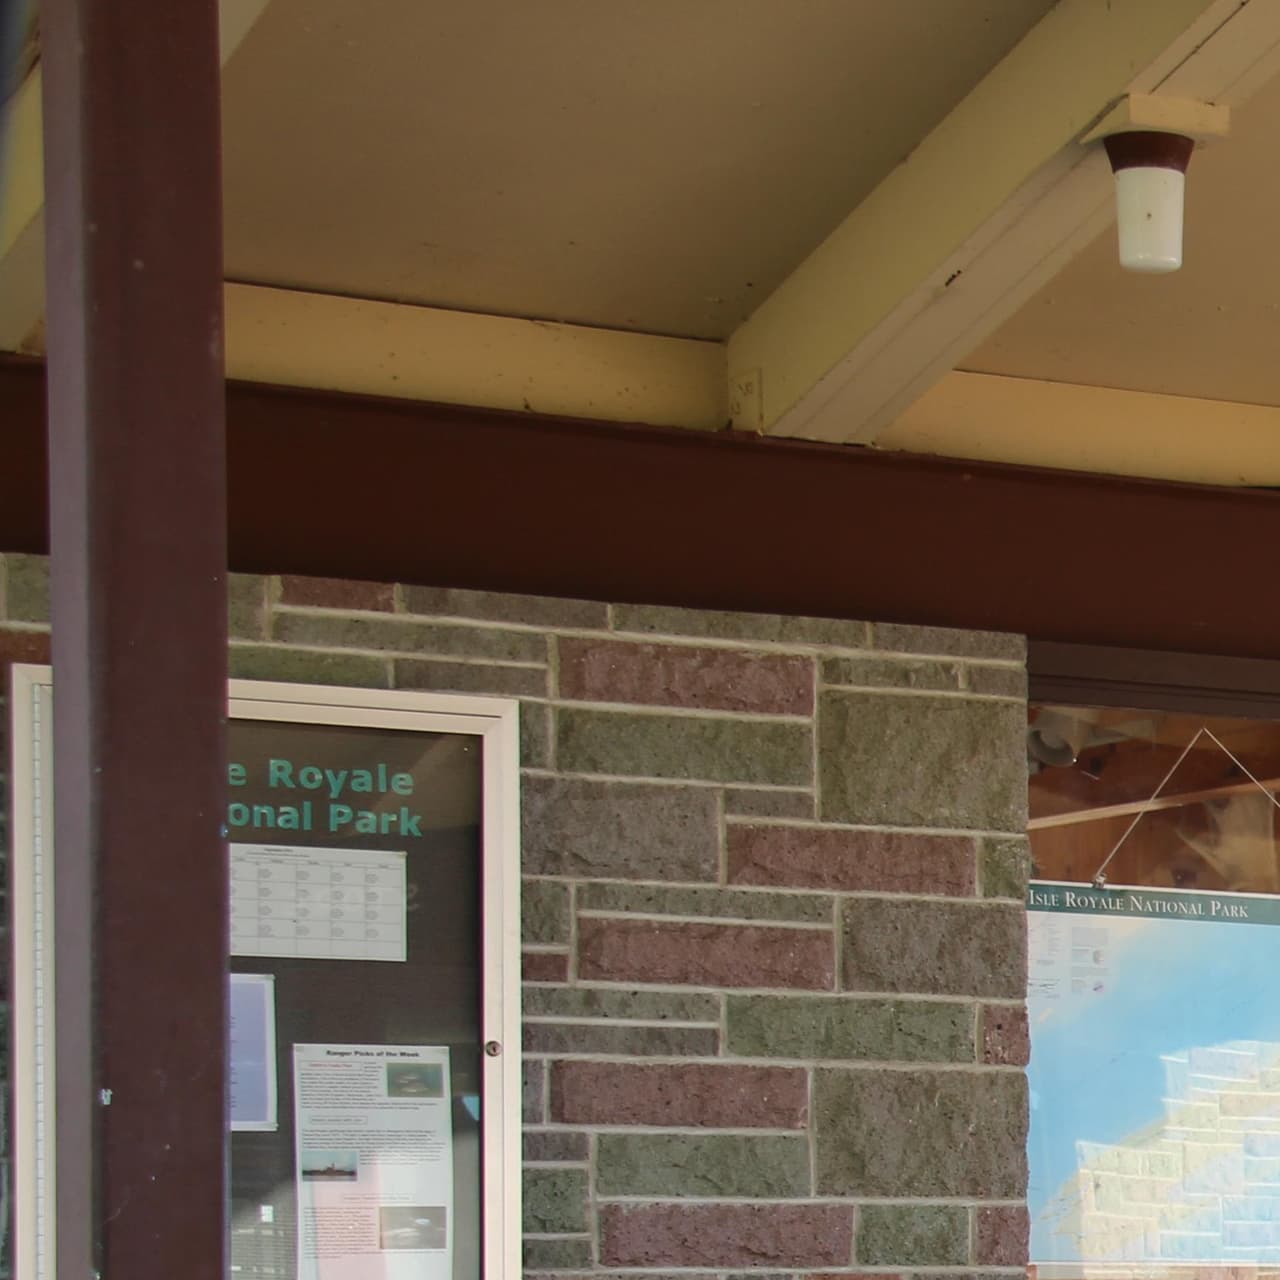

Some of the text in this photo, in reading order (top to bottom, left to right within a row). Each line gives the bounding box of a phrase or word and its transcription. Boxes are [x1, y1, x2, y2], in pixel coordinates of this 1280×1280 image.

[269, 759, 414, 799] Royale
[228, 801, 422, 837] onal Park
[1028, 889, 1249, 918] ISLE ROYALE NATIONAL PARK
